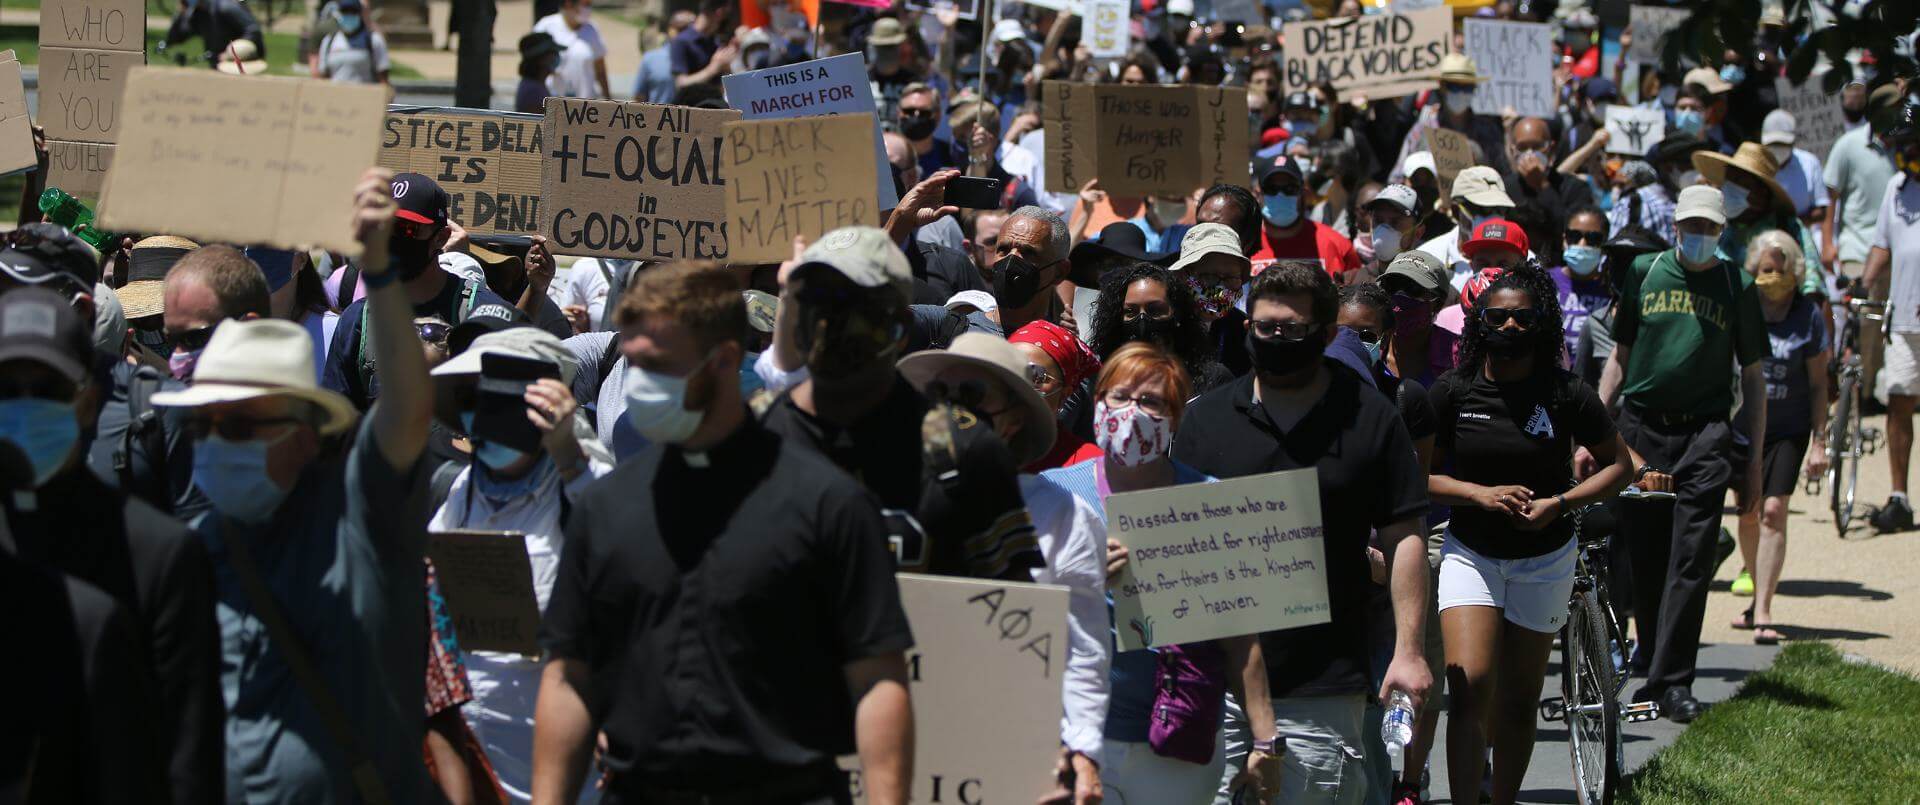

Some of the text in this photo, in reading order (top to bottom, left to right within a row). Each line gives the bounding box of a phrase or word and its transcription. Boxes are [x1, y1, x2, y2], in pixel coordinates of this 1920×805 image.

[60, 4, 125, 45] WHO
[1303, 14, 1414, 55] DEFEND
[1471, 21, 1543, 53] BLACK
[63, 51, 112, 83] ARE
[764, 66, 829, 88] THIS IS A
[1287, 31, 1450, 88] BLACK VOICES!
[1474, 48, 1528, 79] LIVES
[59, 91, 115, 133] YOU
[563, 100, 690, 133] We Are All
[751, 84, 855, 115] MARCH FOR
[382, 117, 474, 152] STICE
[481, 121, 544, 154] DELA
[728, 120, 834, 166] BLACK
[437, 155, 487, 184] IS
[735, 161, 829, 204] LIVES
[472, 190, 540, 232] DENI
[637, 192, 657, 214] in
[552, 207, 729, 261] GOD'S EYES
[1641, 289, 1727, 332] CARROLL
[1524, 403, 1543, 433] PRIME
[1119, 495, 1288, 532] Blessed are those who are
[1136, 533, 1220, 568] persecuted
[1223, 532, 1243, 550] for
[1157, 572, 1179, 589] for
[1180, 568, 1219, 588] theirs
[1223, 565, 1236, 581] is
[1238, 559, 1261, 578] the
[1172, 599, 1190, 620] of
